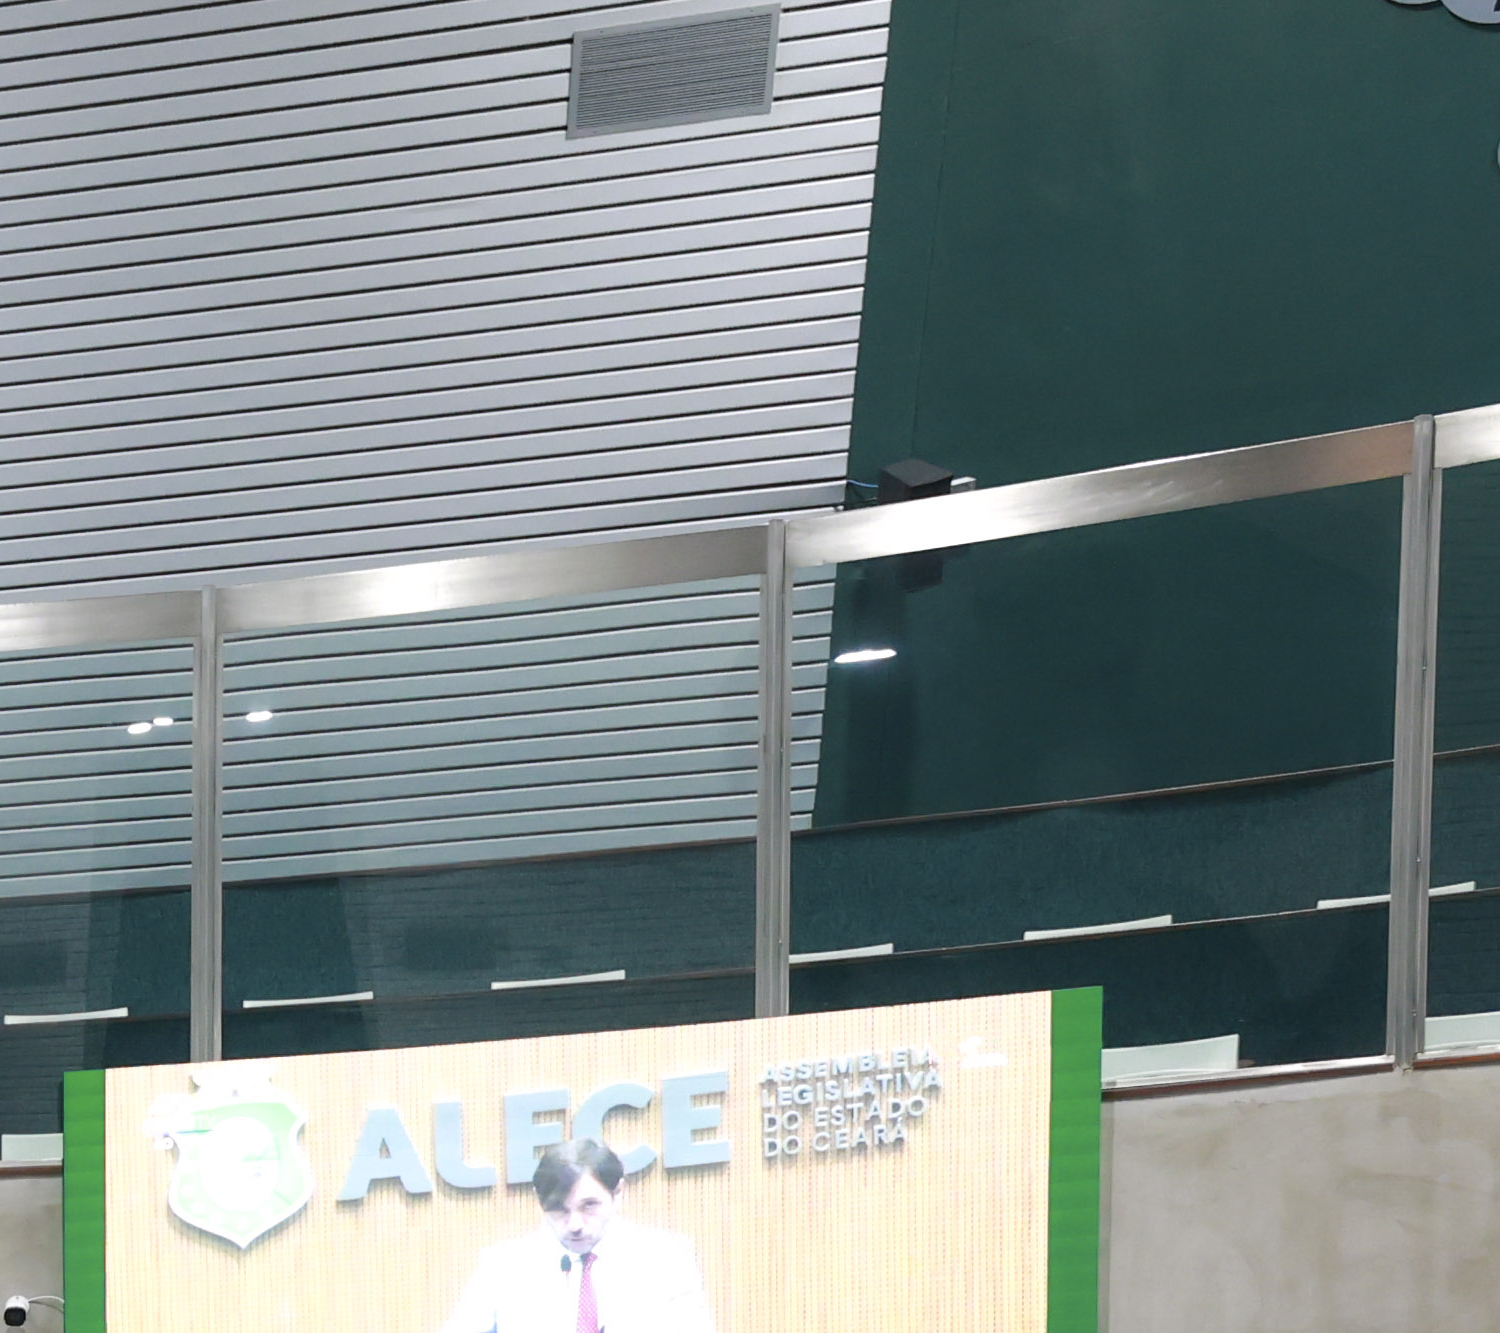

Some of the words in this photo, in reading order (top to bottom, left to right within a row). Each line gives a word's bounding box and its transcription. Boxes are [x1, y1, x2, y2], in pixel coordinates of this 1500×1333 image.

[762, 1067, 943, 1107] LEGISLATIVA
[764, 1110, 801, 1133] DO
[814, 1095, 928, 1127] ESTADO
[335, 1071, 731, 1201] ALECE
[764, 1135, 801, 1157] DO
[812, 1116, 907, 1151] CEARÁ
